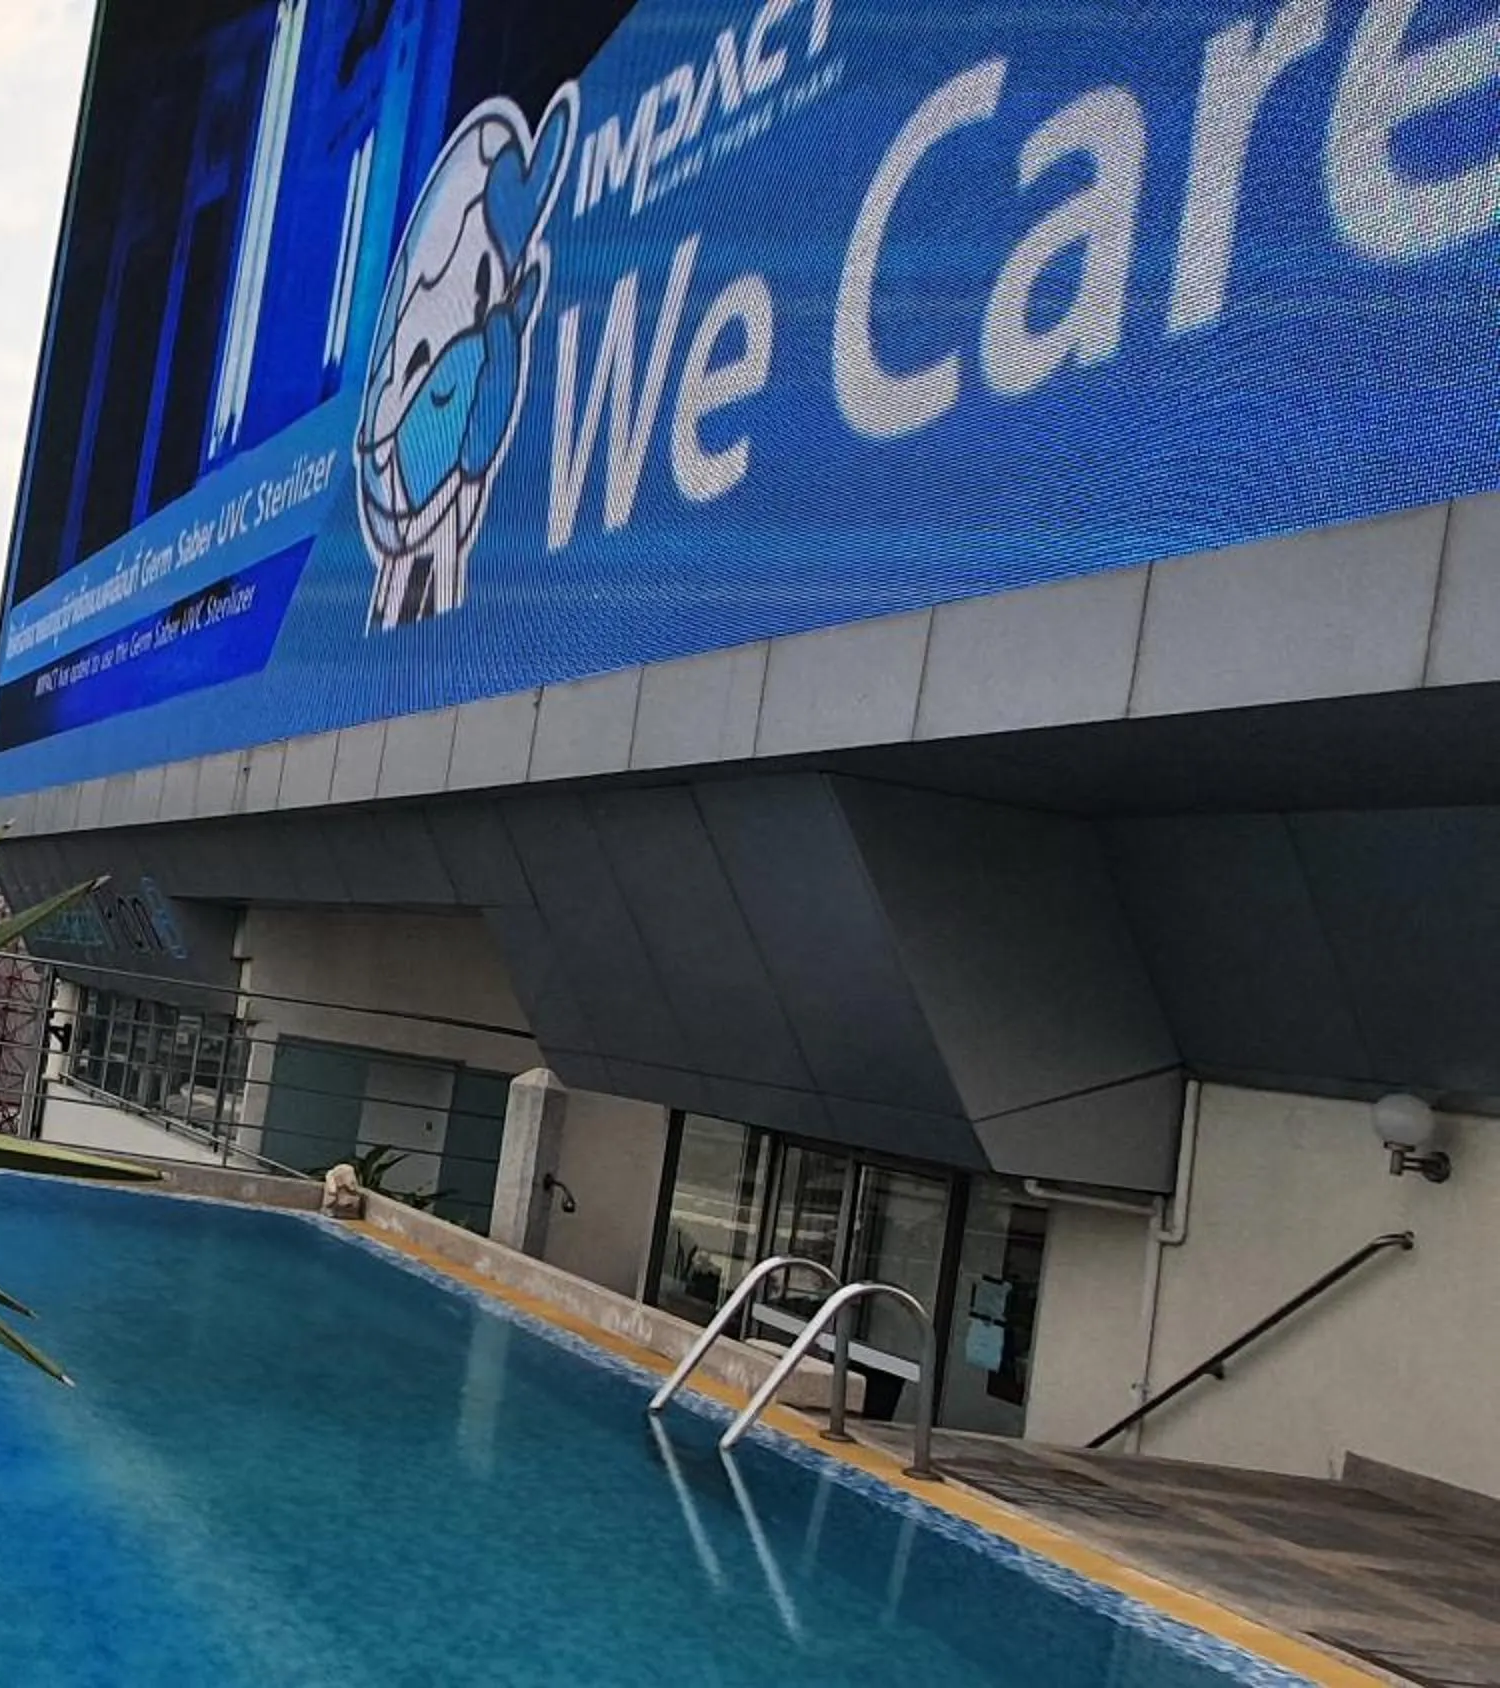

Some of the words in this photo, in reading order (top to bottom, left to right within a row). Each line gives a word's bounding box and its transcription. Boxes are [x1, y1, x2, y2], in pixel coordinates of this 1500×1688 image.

[548, 233, 772, 552] We
[832, 0, 1500, 438] Care
[141, 546, 174, 588] Germ
[175, 518, 216, 568] Saber
[217, 488, 253, 545] UVC
[254, 449, 337, 528] Sterilizer
